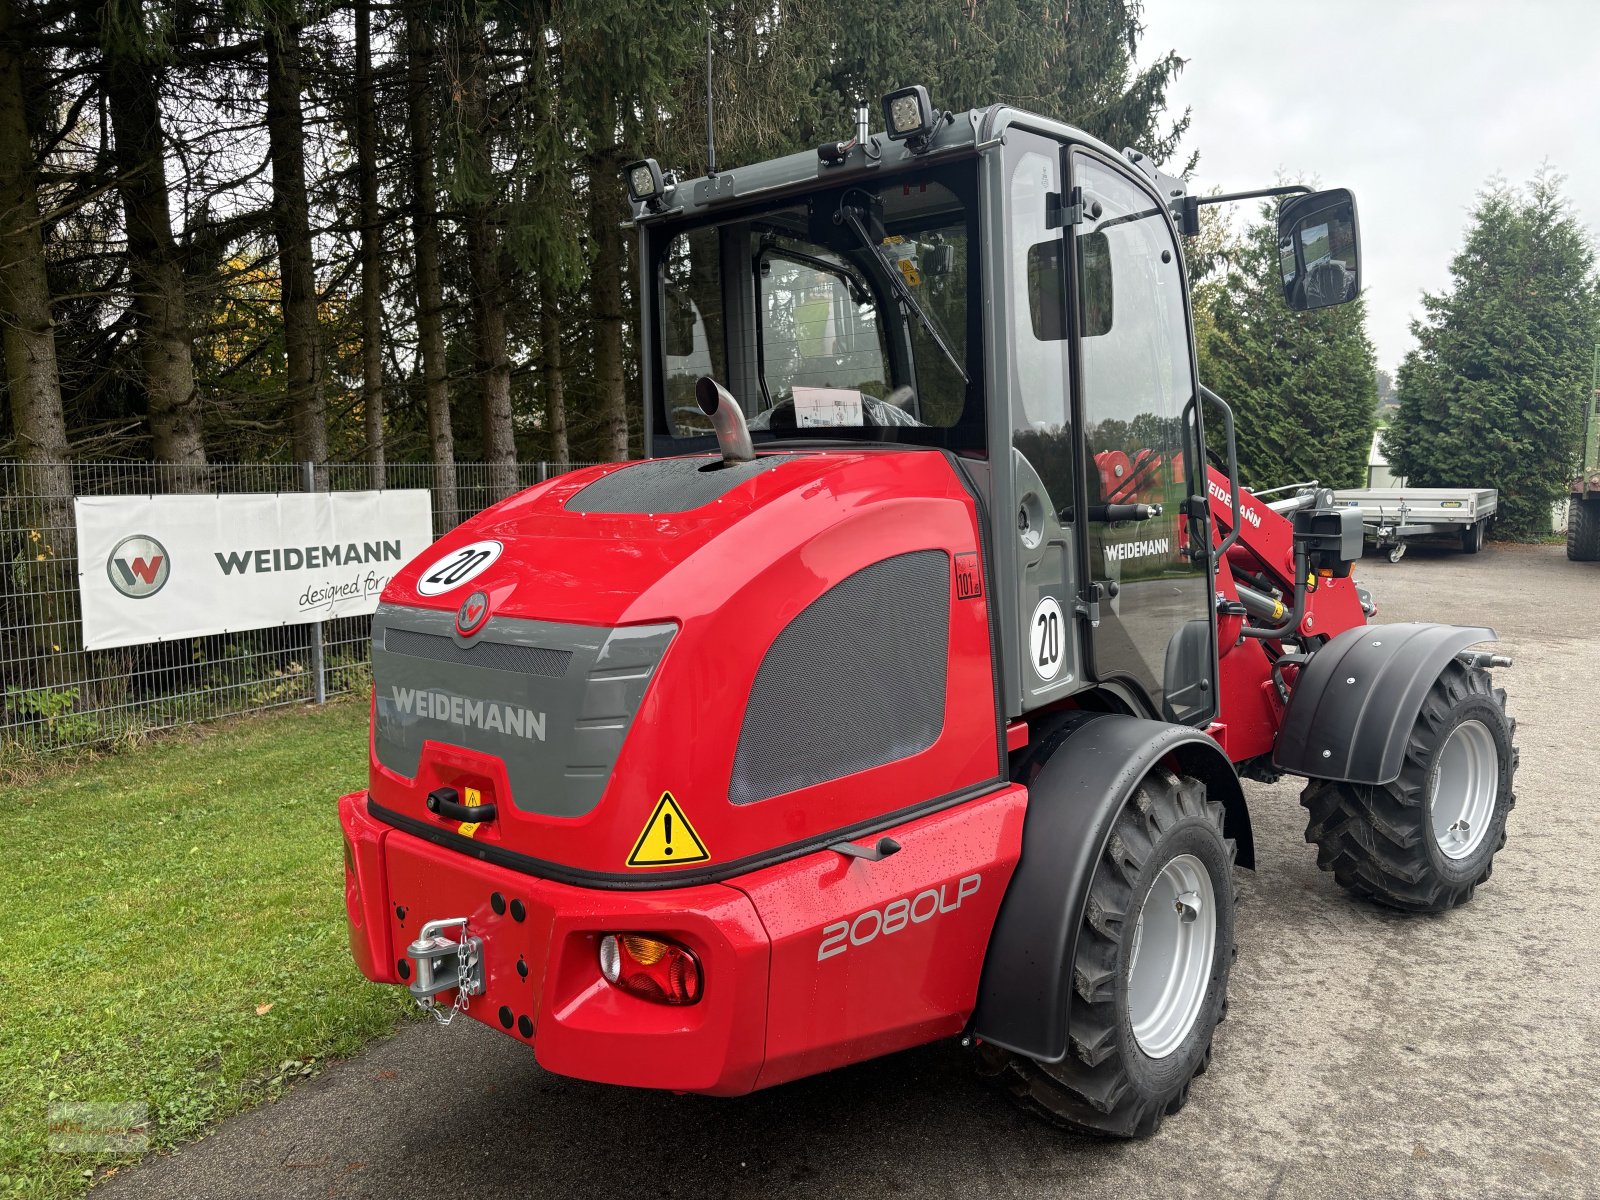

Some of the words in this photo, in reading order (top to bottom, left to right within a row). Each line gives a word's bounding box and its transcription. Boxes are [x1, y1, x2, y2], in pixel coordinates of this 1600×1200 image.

[1208, 479, 1261, 528] EIDEANN
[214, 540, 401, 576] WEIDEMANN
[426, 549, 491, 585] 20
[1106, 537, 1169, 561] WEIDEMANN
[114, 555, 164, 586] W
[958, 571, 974, 596] 101
[299, 574, 361, 611] designed
[362, 570, 385, 601] for
[1037, 611, 1059, 667] 20
[392, 685, 546, 742] WEIDEMANN
[817, 873, 982, 962] 2080LP
